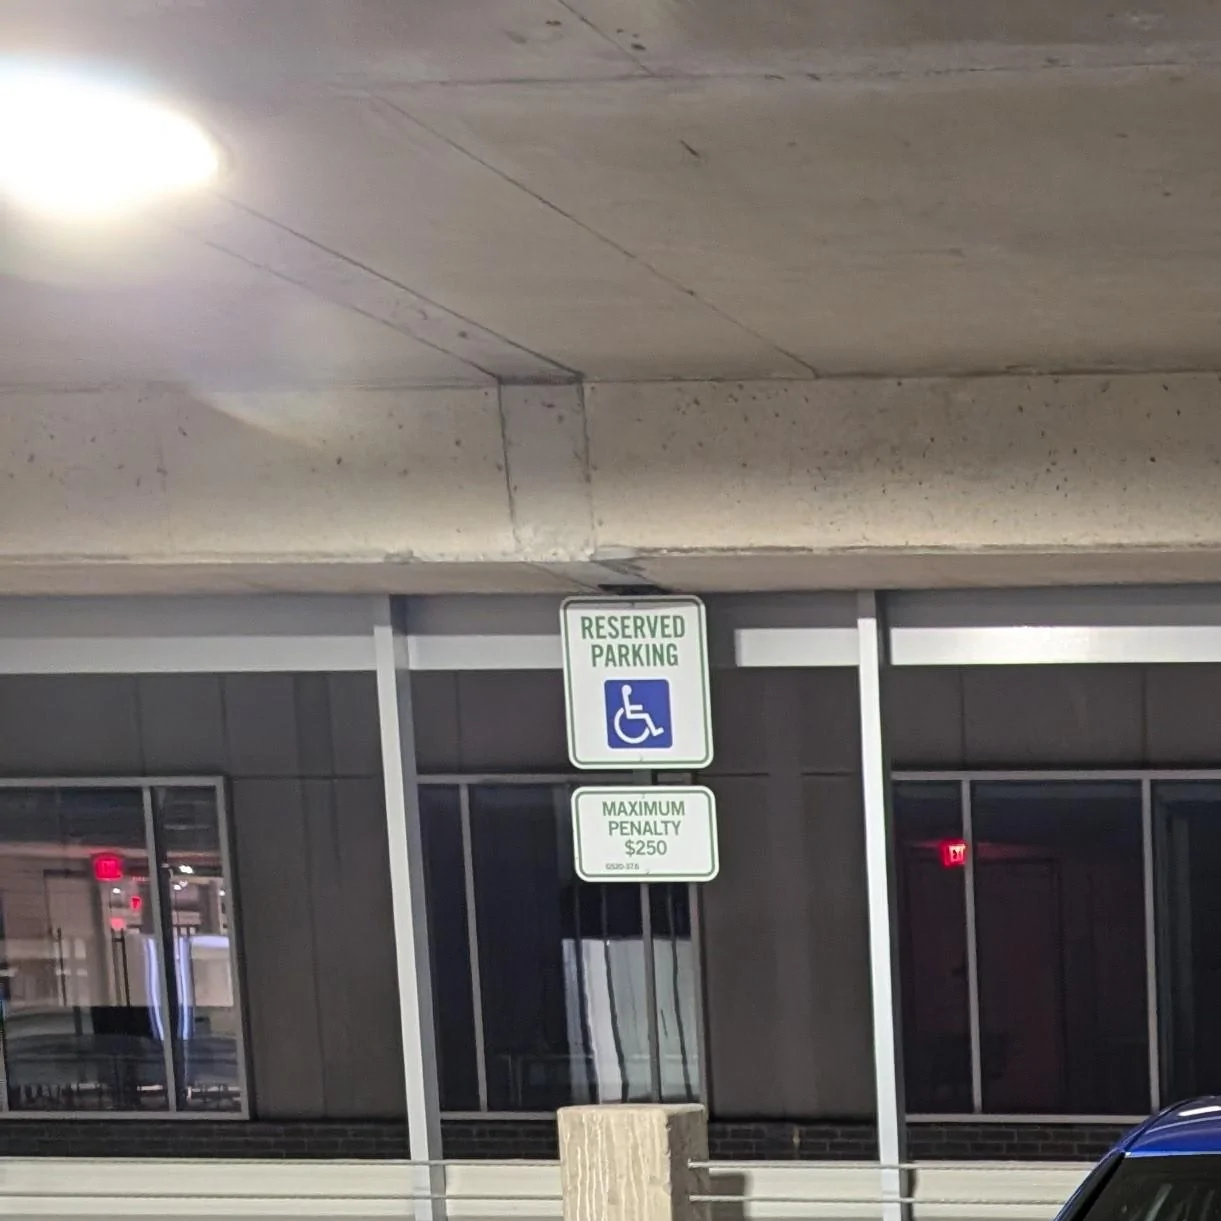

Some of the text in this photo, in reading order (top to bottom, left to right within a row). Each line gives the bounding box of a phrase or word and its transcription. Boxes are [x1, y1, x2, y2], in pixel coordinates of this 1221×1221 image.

[580, 615, 685, 639] RESERVED
[591, 643, 678, 667] PARKING
[602, 801, 685, 816] MAXIMUM
[608, 820, 681, 836] PENALTY
[624, 839, 667, 857] $250
